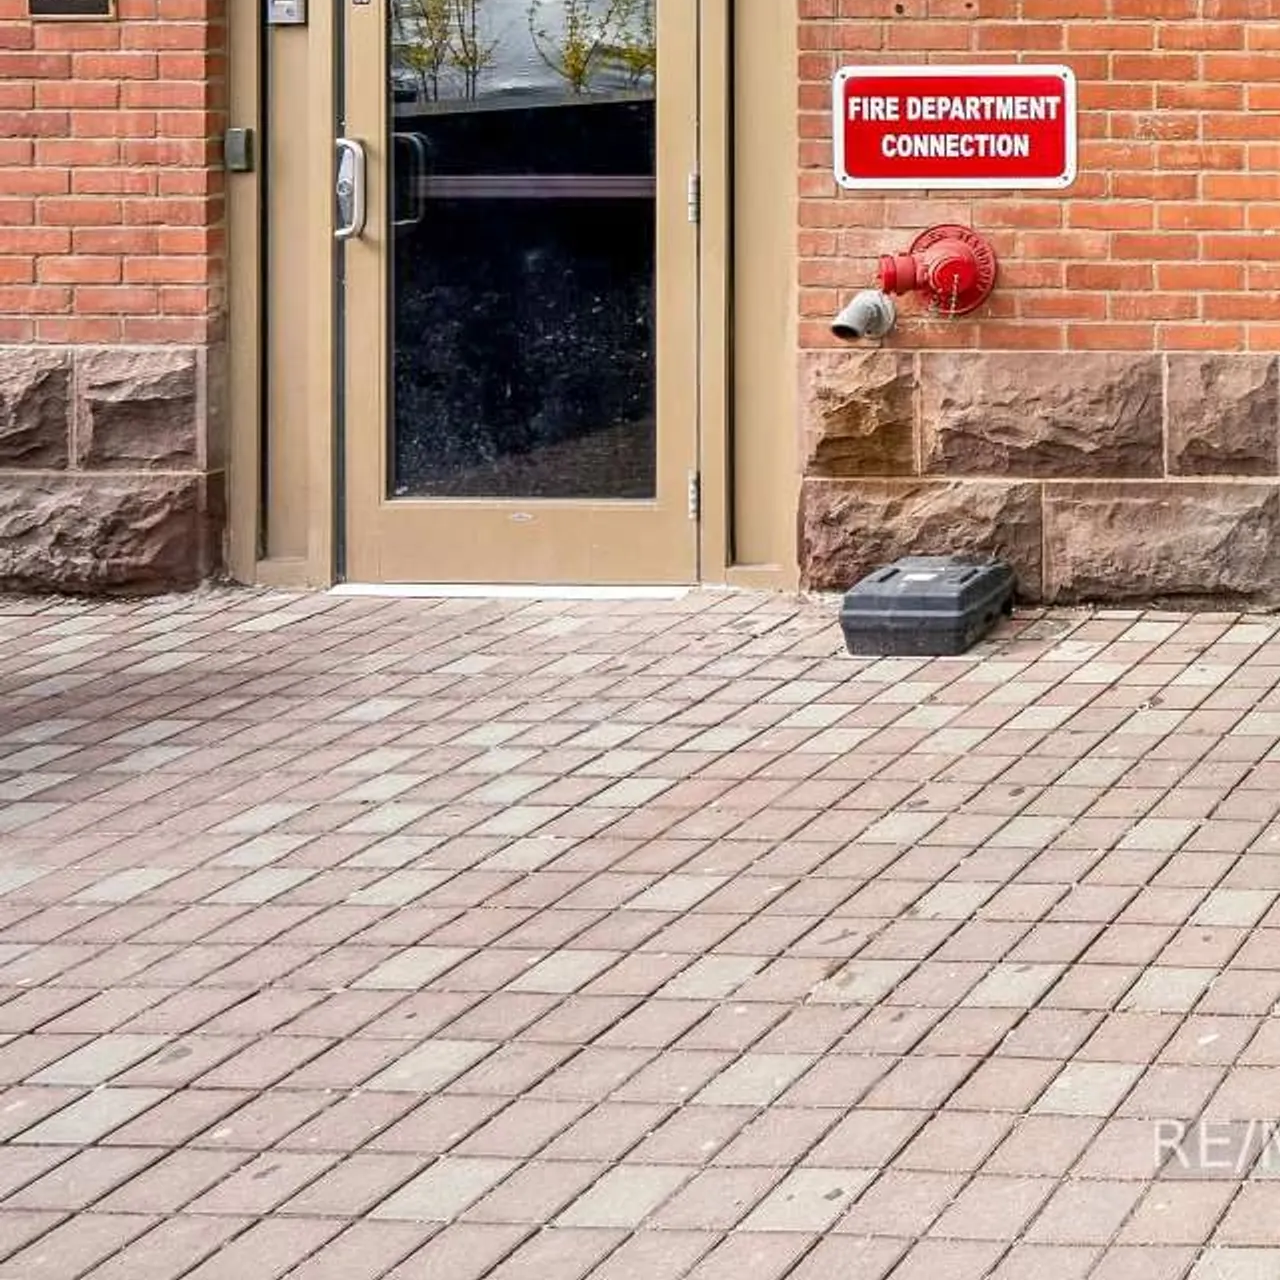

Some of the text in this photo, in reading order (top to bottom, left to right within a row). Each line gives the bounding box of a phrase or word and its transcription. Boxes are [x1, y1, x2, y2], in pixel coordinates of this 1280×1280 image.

[848, 96, 1061, 121] FIRE DEPARTMENT
[881, 133, 1030, 158] CONNECTION
